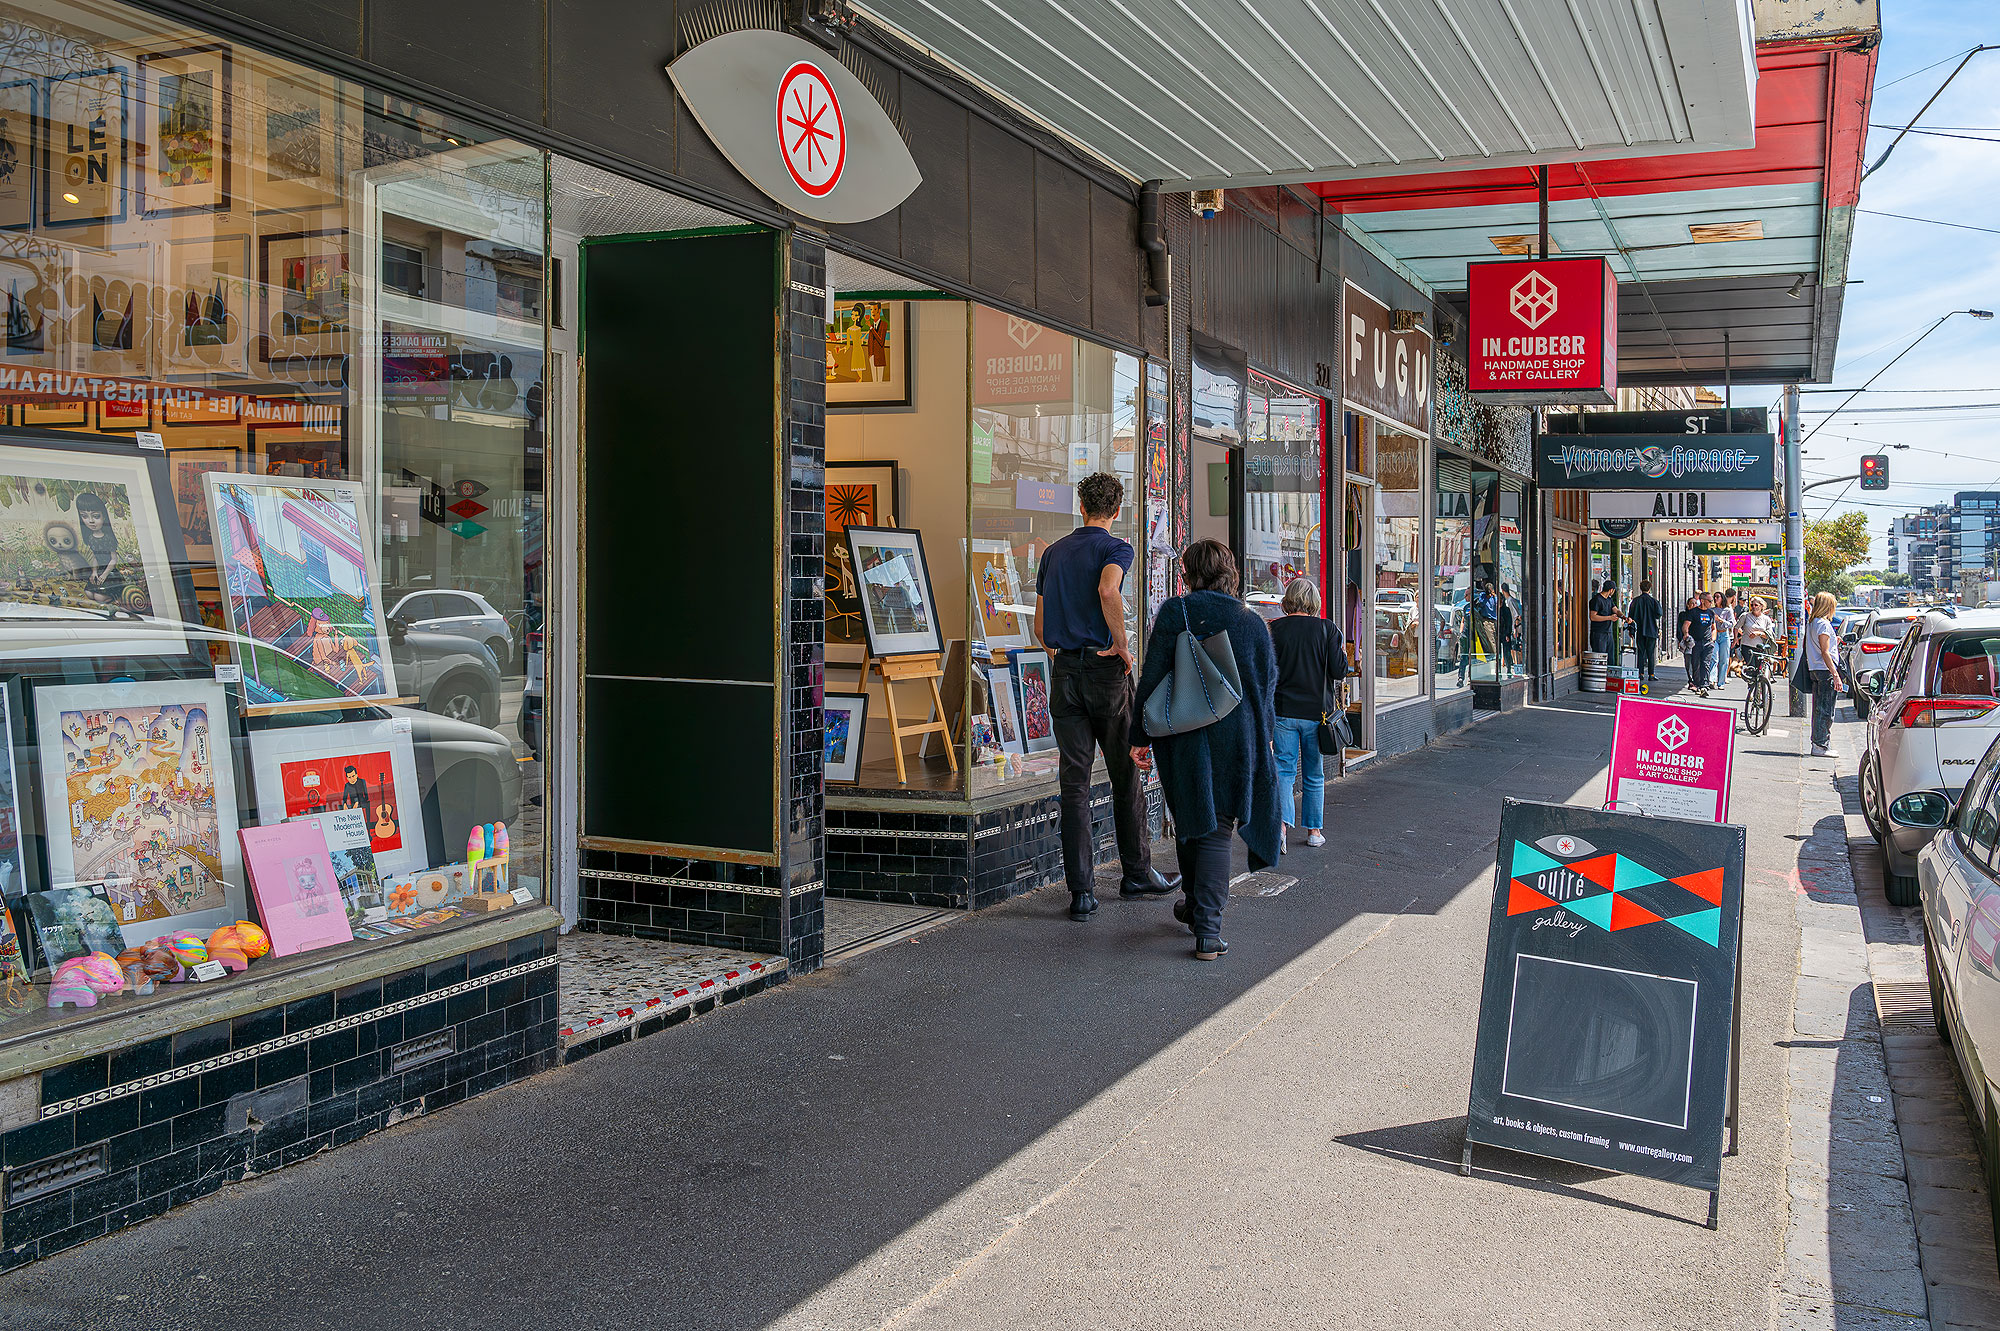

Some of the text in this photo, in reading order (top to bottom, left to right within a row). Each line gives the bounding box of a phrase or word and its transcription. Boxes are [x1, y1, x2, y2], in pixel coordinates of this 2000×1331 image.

[1482, 334, 1586, 358] IN.CUBE8R
[1351, 313, 1427, 408] FUGU
[1484, 358, 1585, 371] HANDMADE SHOP
[1488, 369, 1580, 380] & ART GALLERY
[1561, 444, 1747, 480] VINTAGE GARAGE
[302, 488, 341, 524] NAPIER
[1652, 492, 1706, 517] ALIBI
[1668, 528, 1757, 537] SHOP RAMEN
[1636, 749, 1705, 769] IN.CUBE8R
[1942, 757, 1977, 767] RAV4
[1636, 762, 1703, 778] HANDMADE SHOP
[1645, 770, 1662, 779] ART
[1662, 772, 1699, 784] GALLERY
[333, 822, 365, 832] Modernist
[334, 813, 362, 823] The New
[345, 829, 366, 838] House
[1537, 867, 1585, 901] outré
[1532, 911, 1588, 938] gallery
[1493, 1115, 1693, 1164] art, books & objects, custom framing www.outregallery.com
